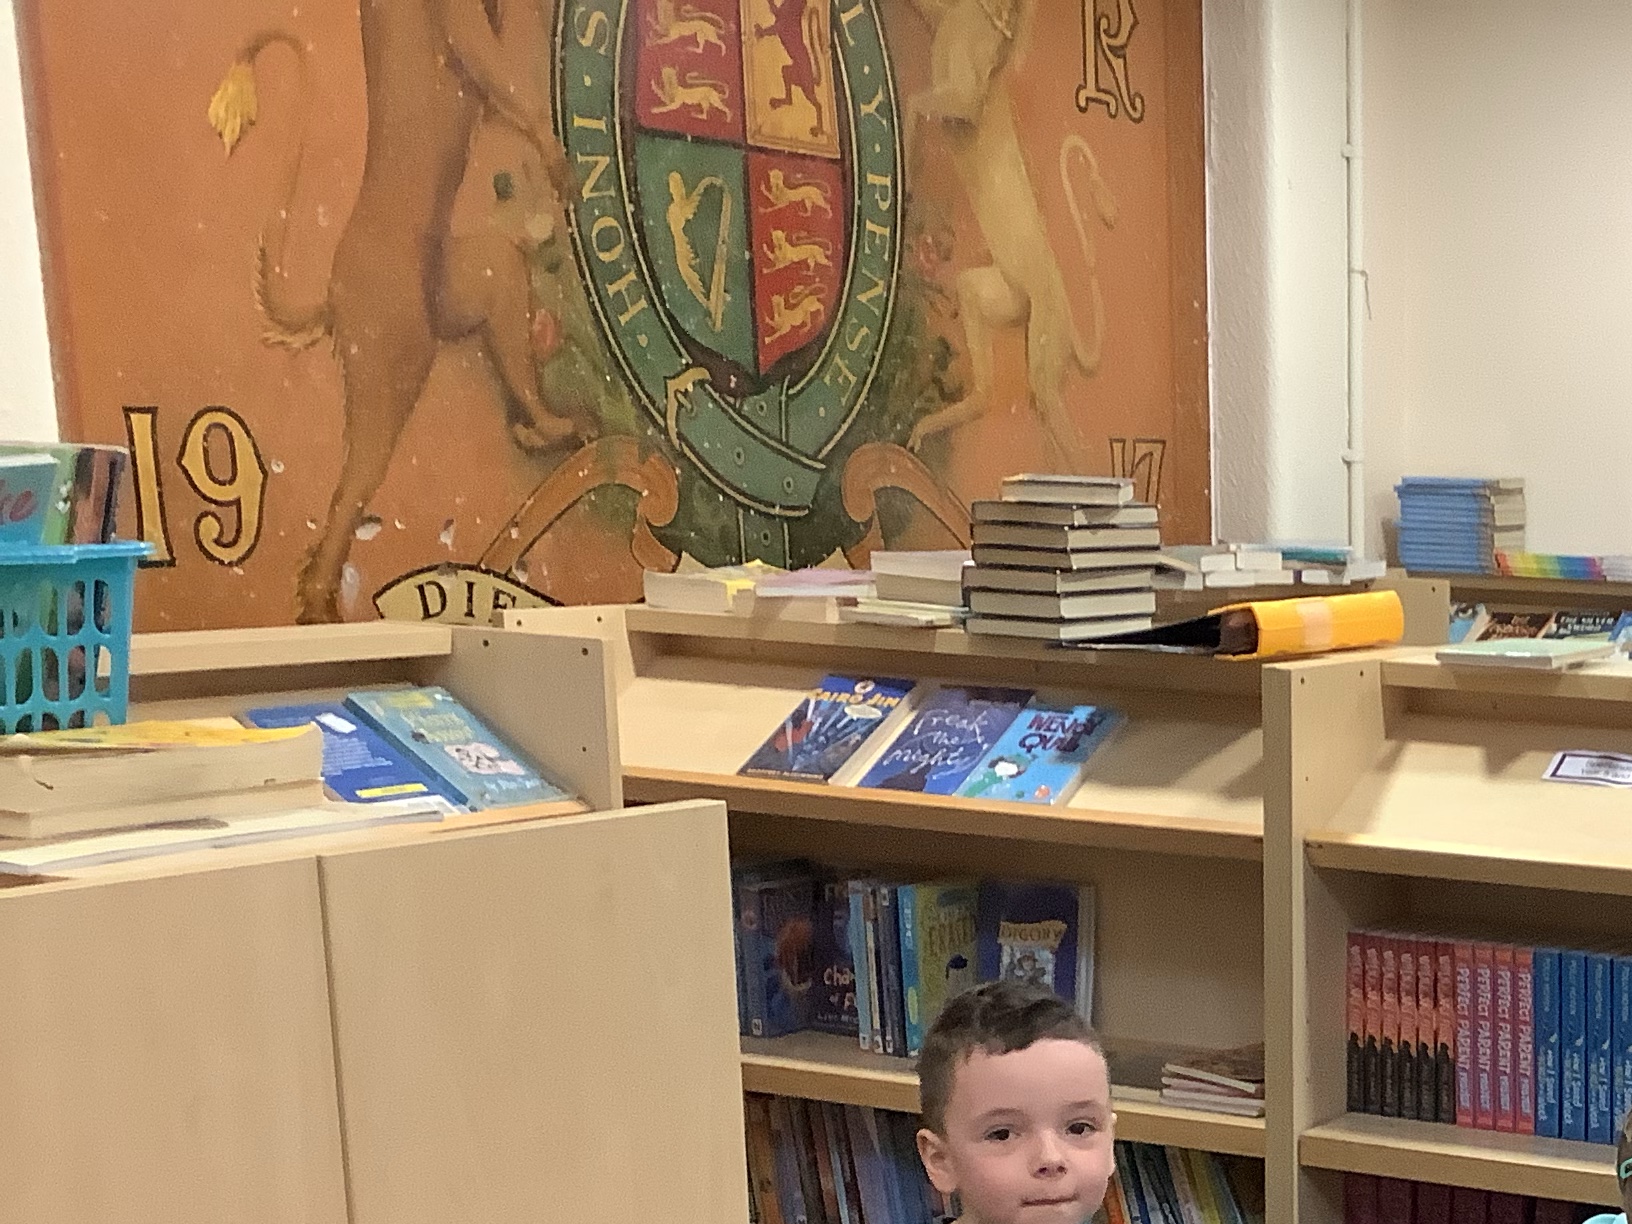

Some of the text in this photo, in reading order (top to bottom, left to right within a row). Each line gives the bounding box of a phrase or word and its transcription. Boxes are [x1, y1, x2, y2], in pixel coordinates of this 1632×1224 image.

[573, 115, 648, 326] HONI
[823, 172, 892, 408] PENSE
[122, 406, 268, 568] 19
[1456, 967, 1471, 1016] PERFECT
[1477, 967, 1491, 1017] PERFECT
[1498, 970, 1512, 1020] PERFECT
[1518, 972, 1532, 1022] PERFECT
[1456, 1020, 1471, 1071] PARENT
[1477, 1020, 1491, 1072] PARENT
[1498, 1022, 1512, 1075] PARENT
[1518, 1024, 1533, 1077] PARENT
